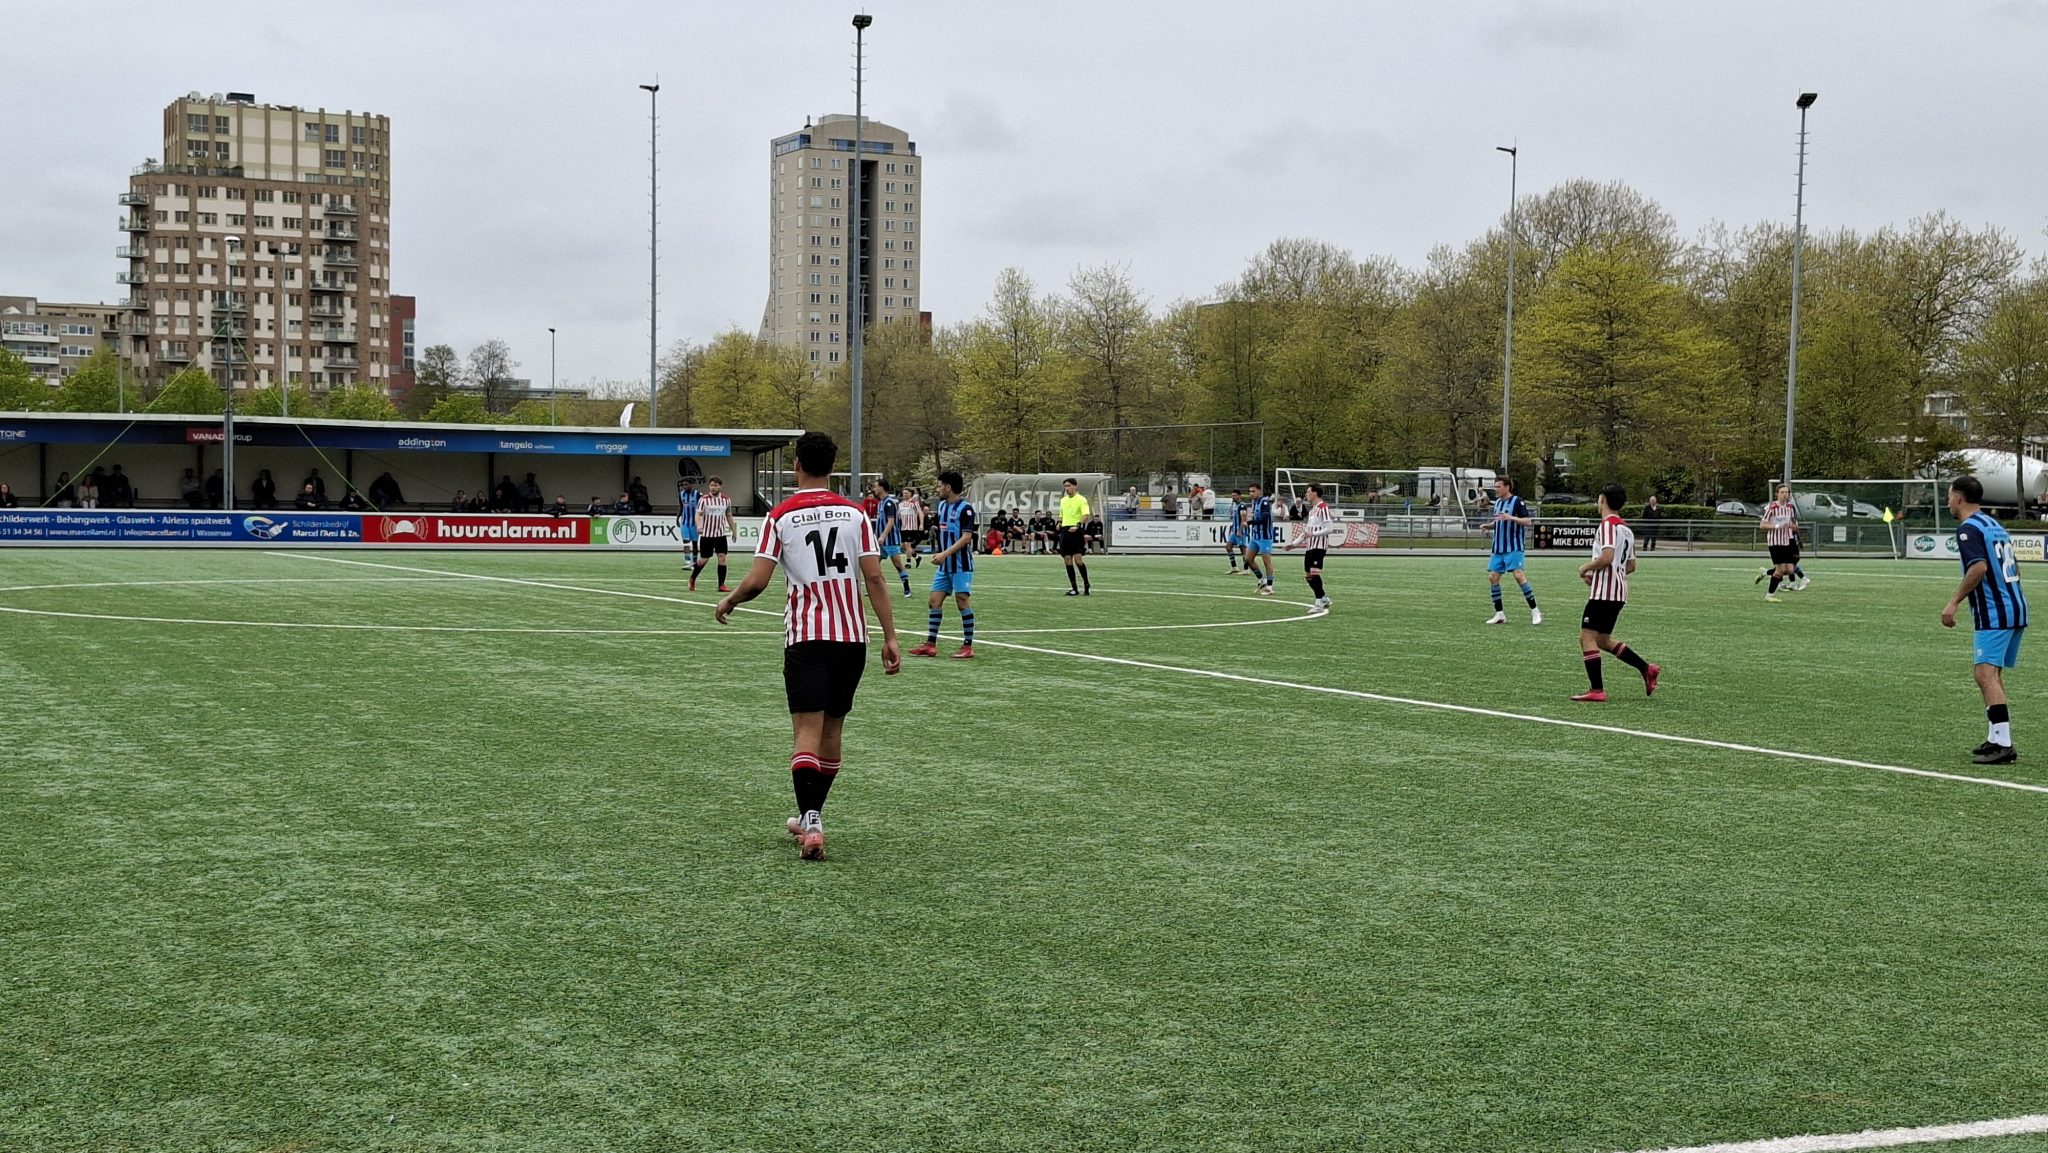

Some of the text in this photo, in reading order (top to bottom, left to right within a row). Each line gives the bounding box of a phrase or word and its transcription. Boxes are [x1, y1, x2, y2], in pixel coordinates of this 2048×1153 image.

[398, 438, 447, 448] addington
[595, 443, 628, 453] engage
[677, 444, 724, 453] EARLY FRIDAY
[984, 490, 1063, 510] GASTE
[57, 515, 110, 526] Behangwerk
[117, 515, 155, 524] Glaswerk
[162, 516, 189, 525] Airless
[191, 516, 232, 526] spuitwerk
[791, 512, 821, 524] Clair
[824, 510, 851, 519] Bon
[292, 529, 319, 537] Marcel
[340, 529, 347, 537] &
[437, 520, 577, 539] huuralarm.nl
[639, 521, 679, 541] brix
[1552, 527, 1596, 536] FYSIOTHER
[1553, 538, 1572, 546] MIKE
[805, 526, 848, 576] 14
